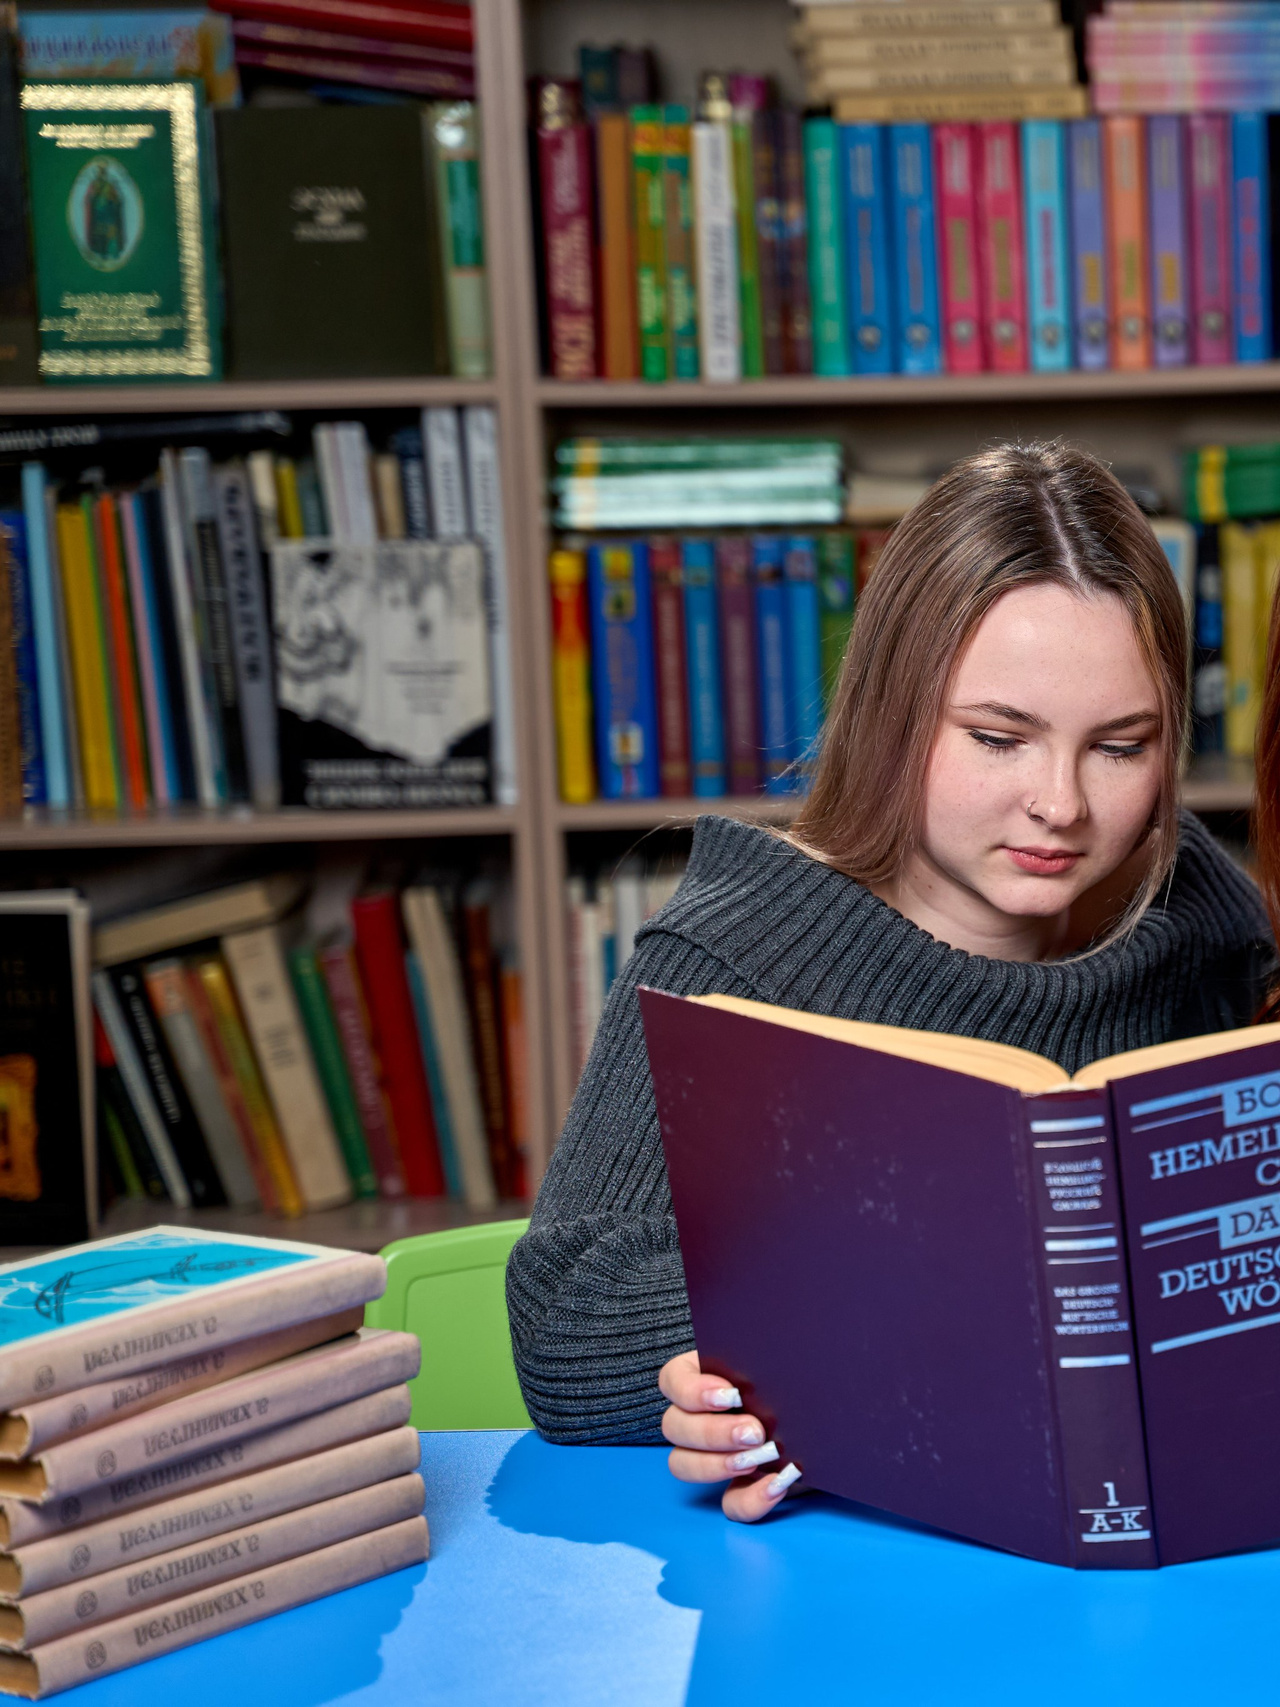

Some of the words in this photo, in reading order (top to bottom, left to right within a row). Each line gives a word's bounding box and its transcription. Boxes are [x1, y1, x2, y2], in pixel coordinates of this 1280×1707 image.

[83, 1319, 198, 1373] ХЕМИНГУЭЙ
[143, 1402, 252, 1457] ХЕМИНГУЭЙ
[1090, 1511, 1143, 1532] A-K
[1103, 1482, 1119, 1507] 1
[119, 1500, 234, 1552] ХЕМИНГУЭЙ
[127, 1540, 242, 1596] ХЕМИНГУЭЙ
[134, 1586, 248, 1647] ХЕМИНГУЭЙ
